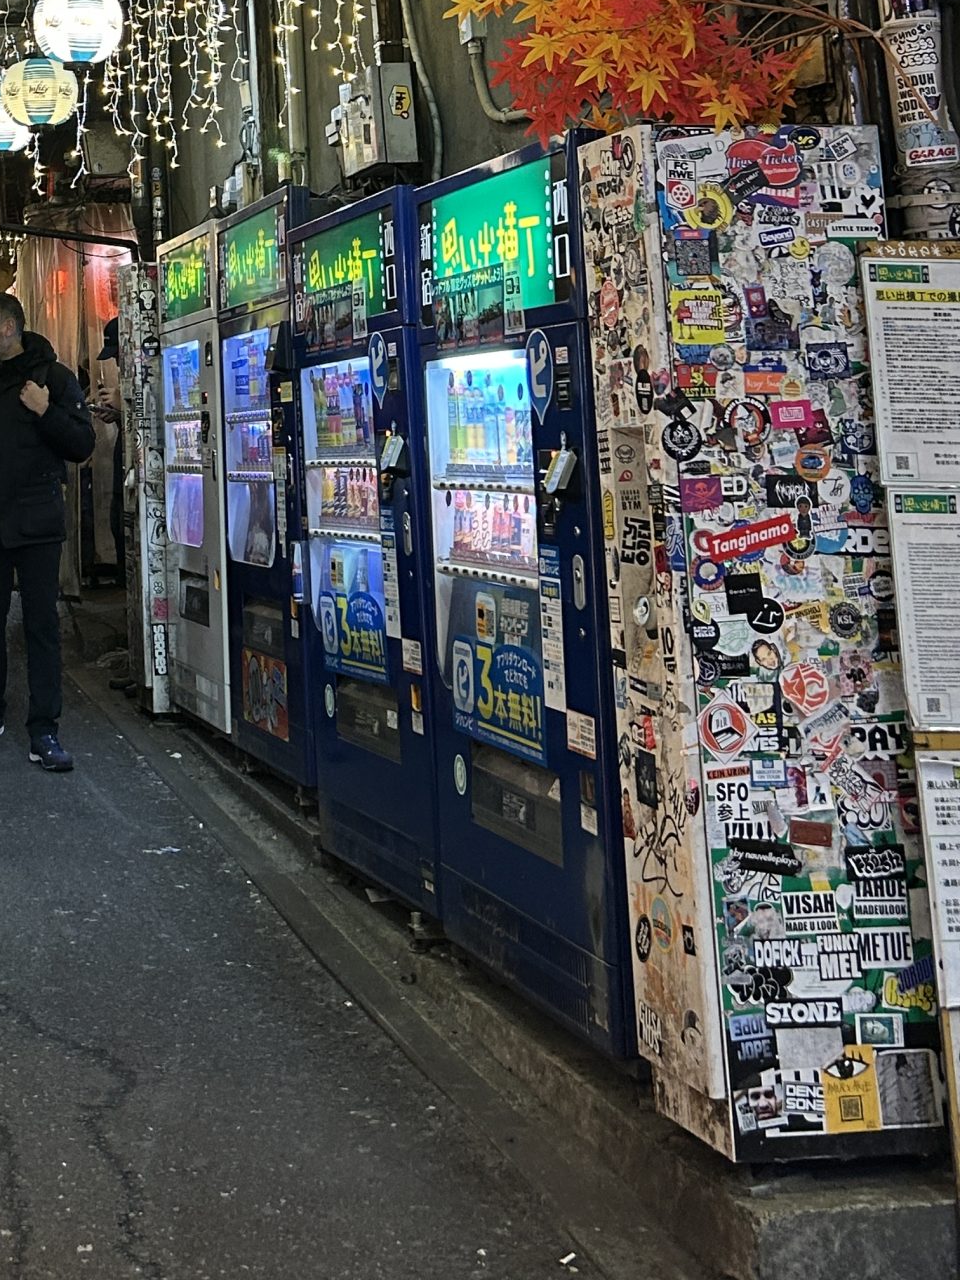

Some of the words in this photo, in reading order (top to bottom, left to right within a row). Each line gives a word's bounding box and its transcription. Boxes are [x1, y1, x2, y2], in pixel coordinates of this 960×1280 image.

[668, 170, 694, 180] RWE
[673, 160, 689, 171] FC
[552, 178, 571, 279] 西口
[760, 229, 793, 242] Beyond
[228, 228, 275, 290] 思い出横丁
[384, 220, 397, 300] 西口
[420, 223, 433, 306] 新宿
[712, 522, 790, 555] Tanginamo
[837, 613, 855, 625] KSL
[716, 782, 749, 802] SFO
[718, 804, 751, 822] 参上
[784, 894, 835, 915] VISAH
[785, 921, 807, 932] MADE
[816, 919, 839, 931] LOOK
[817, 933, 859, 952] FUNKY
[820, 952, 862, 980] MEL
[766, 1001, 841, 1024] STONE
